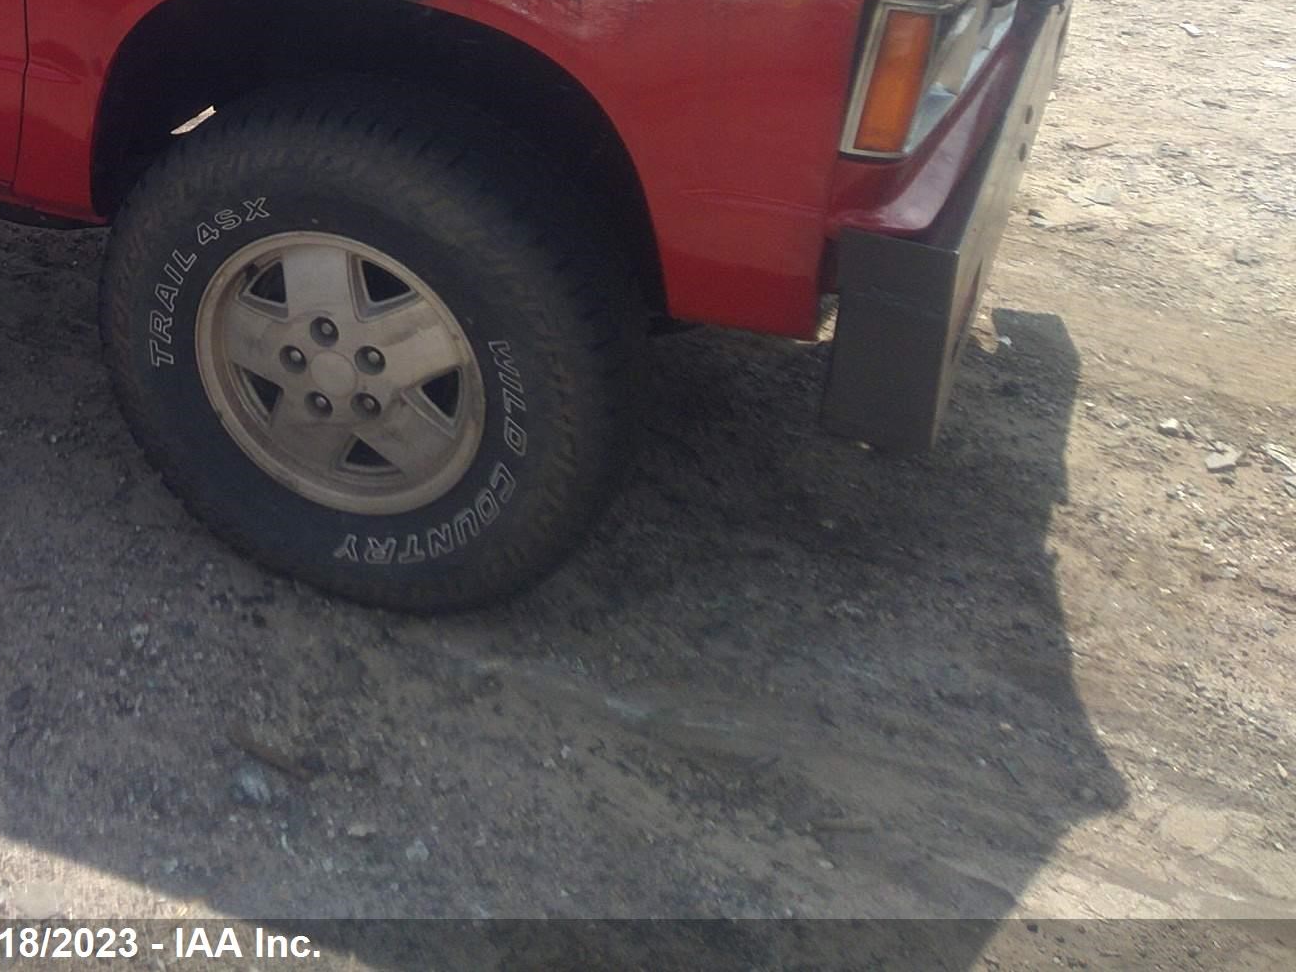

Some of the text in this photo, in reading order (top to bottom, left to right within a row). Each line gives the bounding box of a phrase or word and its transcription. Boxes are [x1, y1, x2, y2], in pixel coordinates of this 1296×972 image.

[149, 196, 271, 368] TRAIL 4SX
[333, 340, 528, 565] WILD COUNTRY
